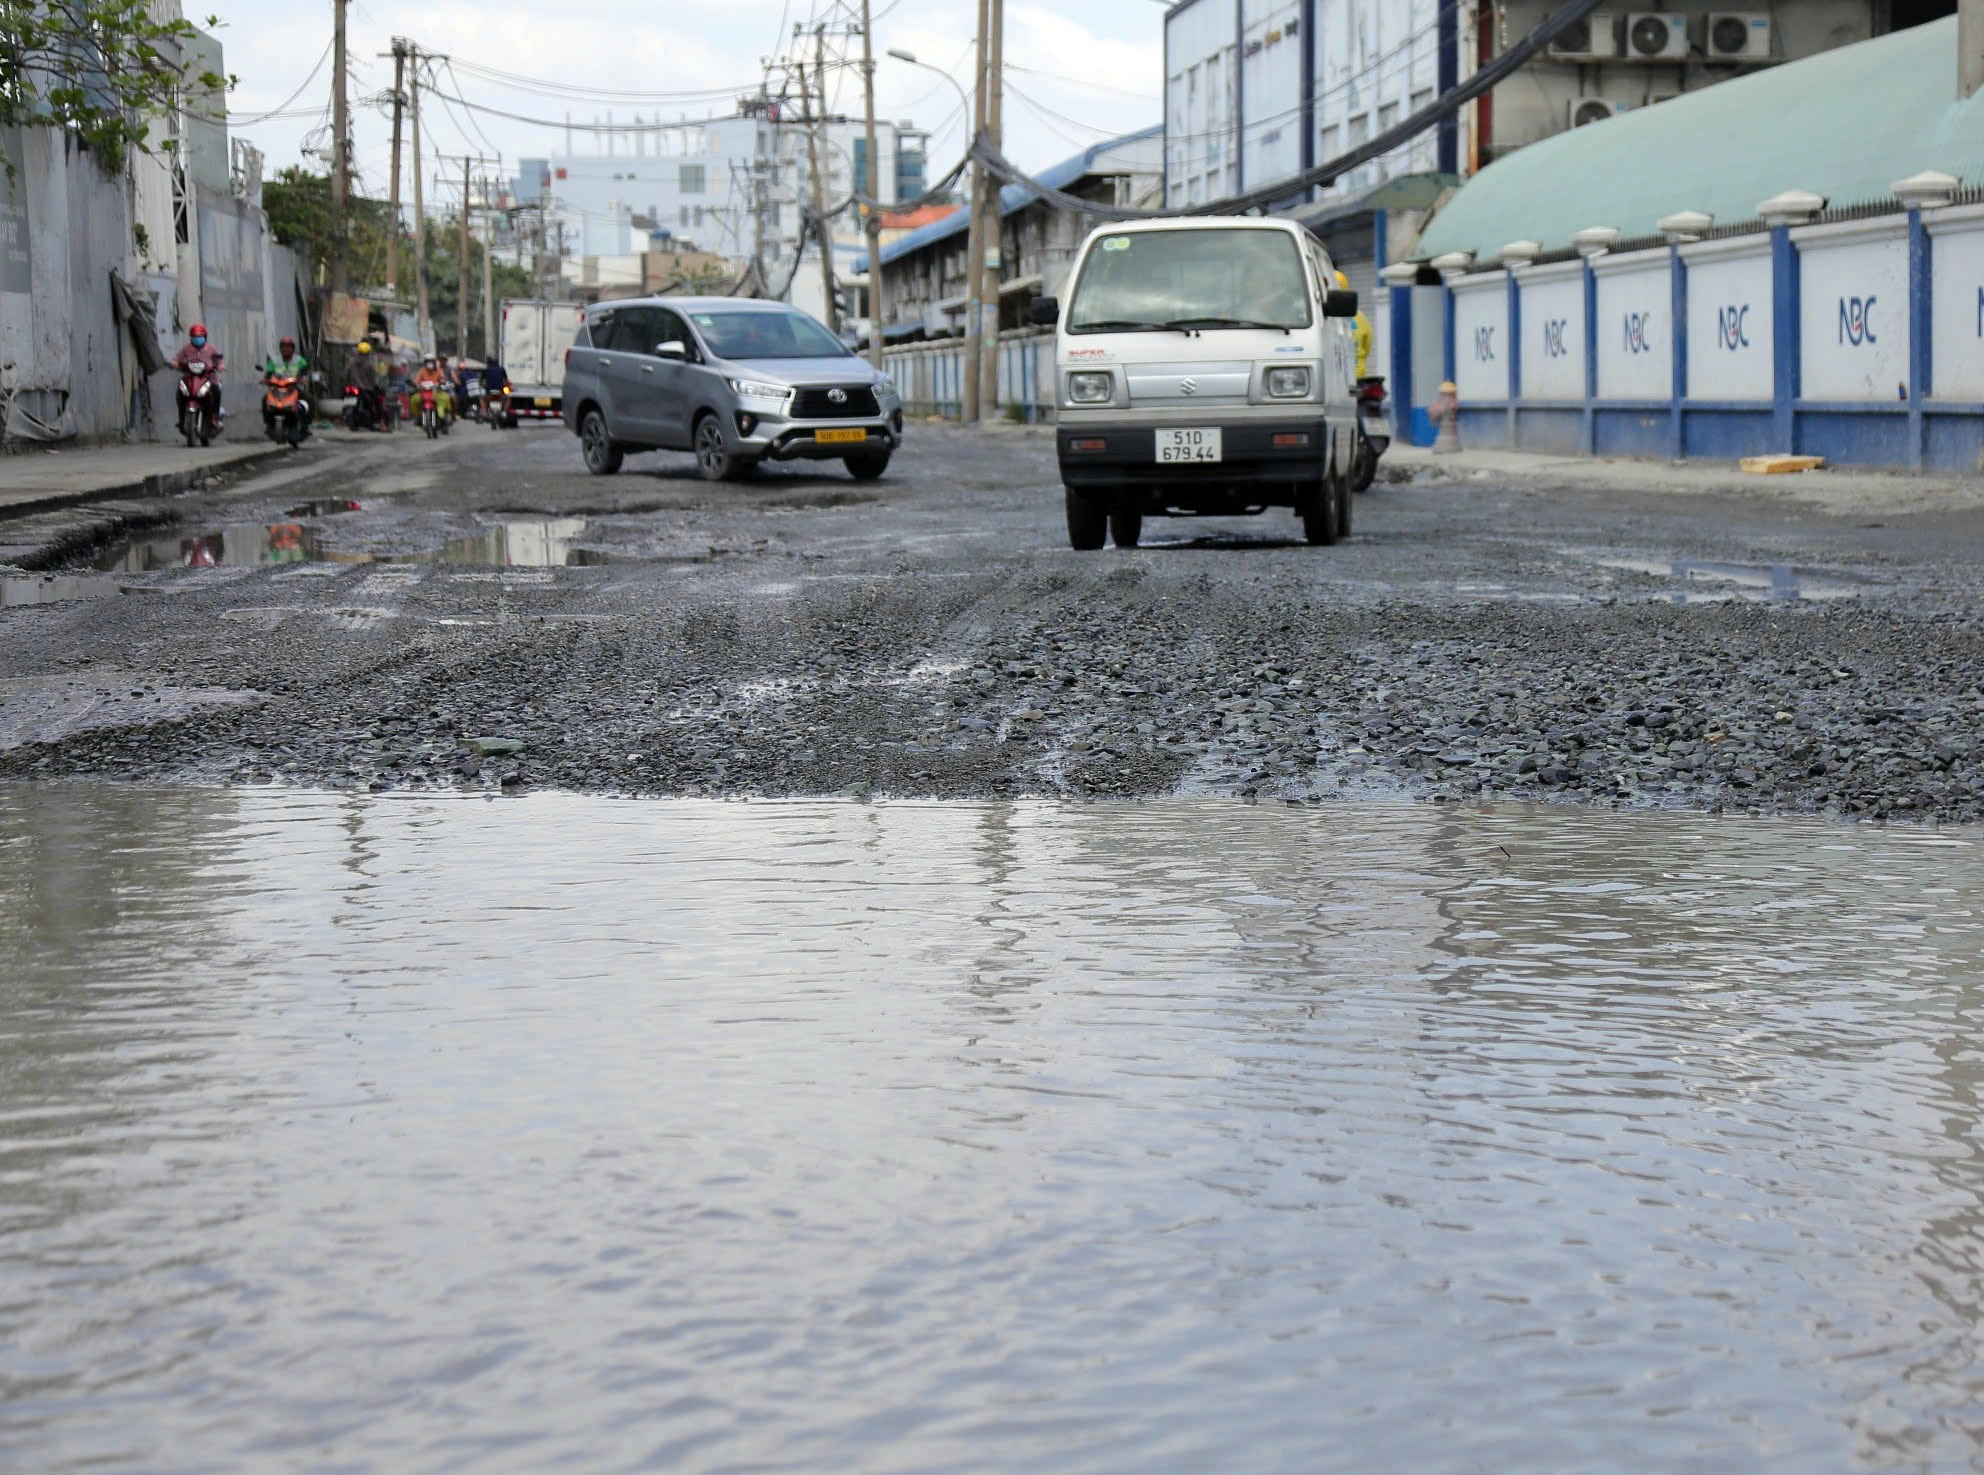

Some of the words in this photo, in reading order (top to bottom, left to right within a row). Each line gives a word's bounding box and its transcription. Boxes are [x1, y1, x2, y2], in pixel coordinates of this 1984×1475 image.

[1718, 304, 1750, 351] NBC
[1838, 295, 1878, 347] NBC
[1068, 348, 1105, 357] SUPER
[1174, 431, 1202, 445] 51D
[1163, 446, 1214, 461] 679.44
